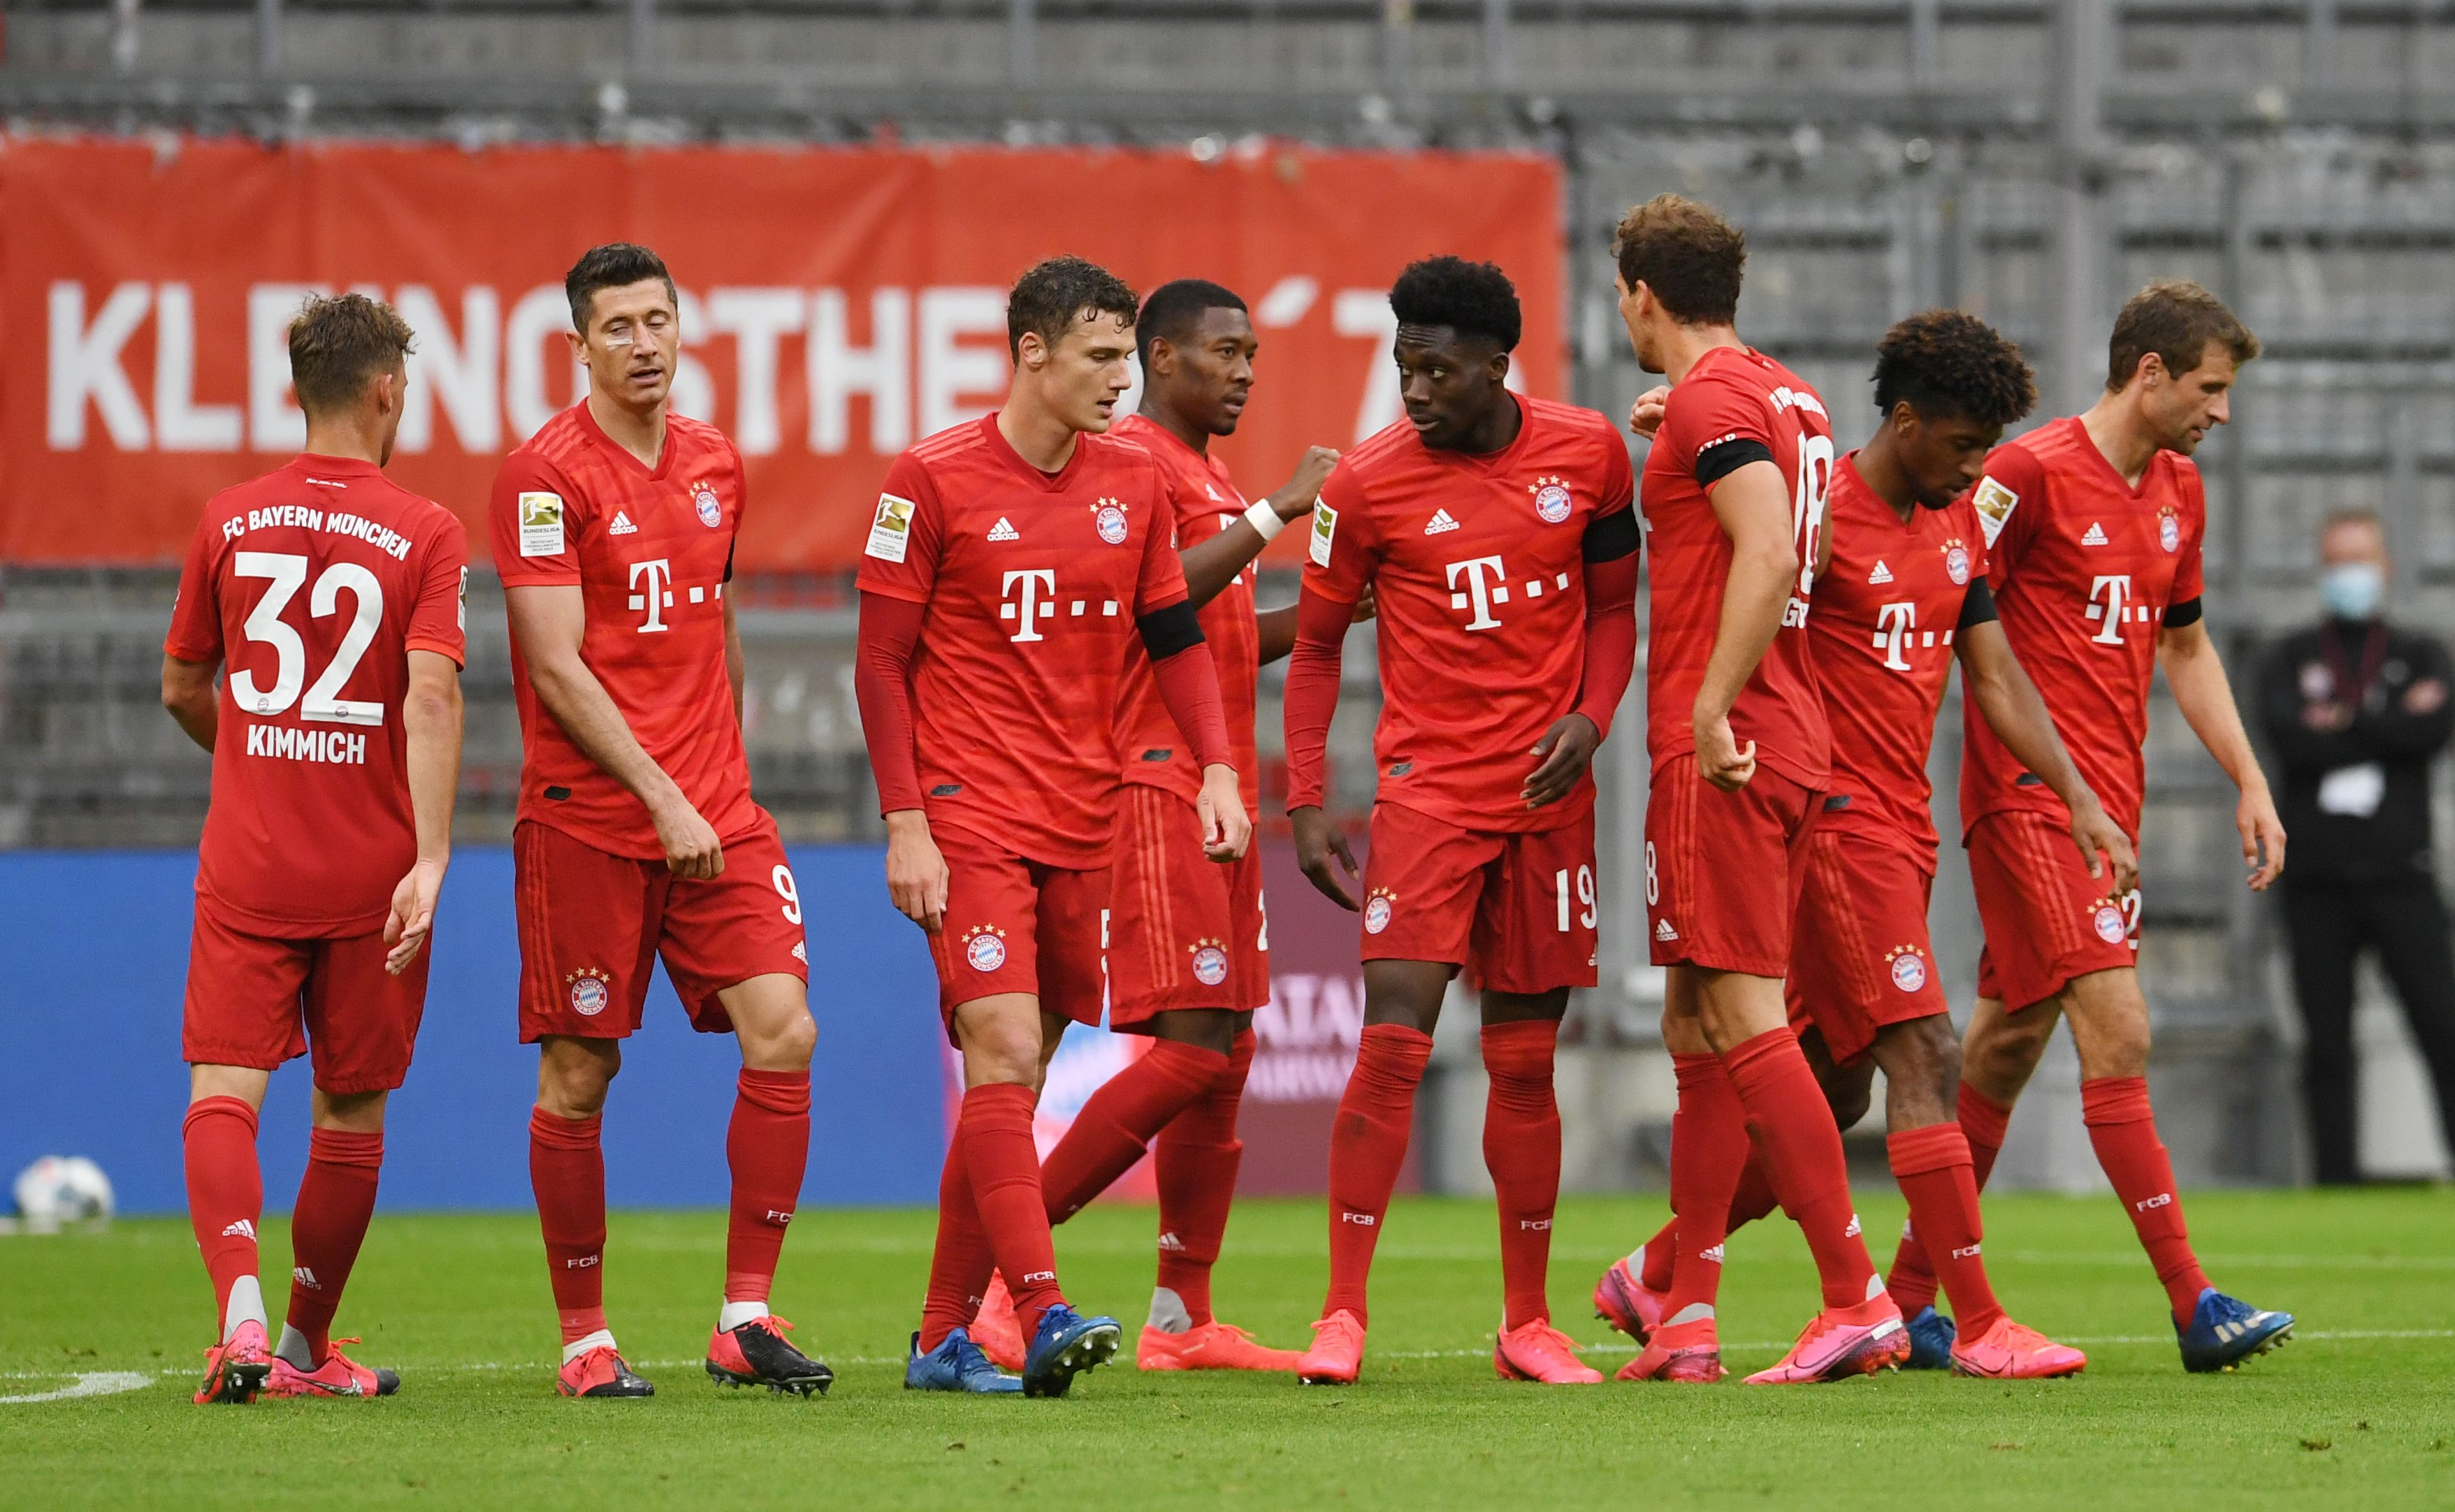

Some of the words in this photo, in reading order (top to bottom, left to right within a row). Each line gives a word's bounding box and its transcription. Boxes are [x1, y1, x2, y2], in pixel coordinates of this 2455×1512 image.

[1795, 430, 1834, 595] 18
[222, 516, 245, 542] FC
[248, 505, 324, 531] BAYERN
[325, 512, 412, 561] MÜNCHEN
[609, 524, 637, 535] adidas
[987, 530, 1020, 542] adidas
[1424, 521, 1460, 536] adidas
[230, 551, 384, 727] 32
[247, 725, 365, 764] KIMMICH
[1646, 841, 1659, 906] 8
[772, 864, 802, 926] 9
[1556, 864, 1597, 931] 19
[2136, 1193, 2171, 1213] FCB
[1343, 1212, 1375, 1226] FCB
[567, 1255, 598, 1269] FCB
[1953, 1244, 1980, 1260] FCB
[1024, 1271, 1055, 1284] FCB
